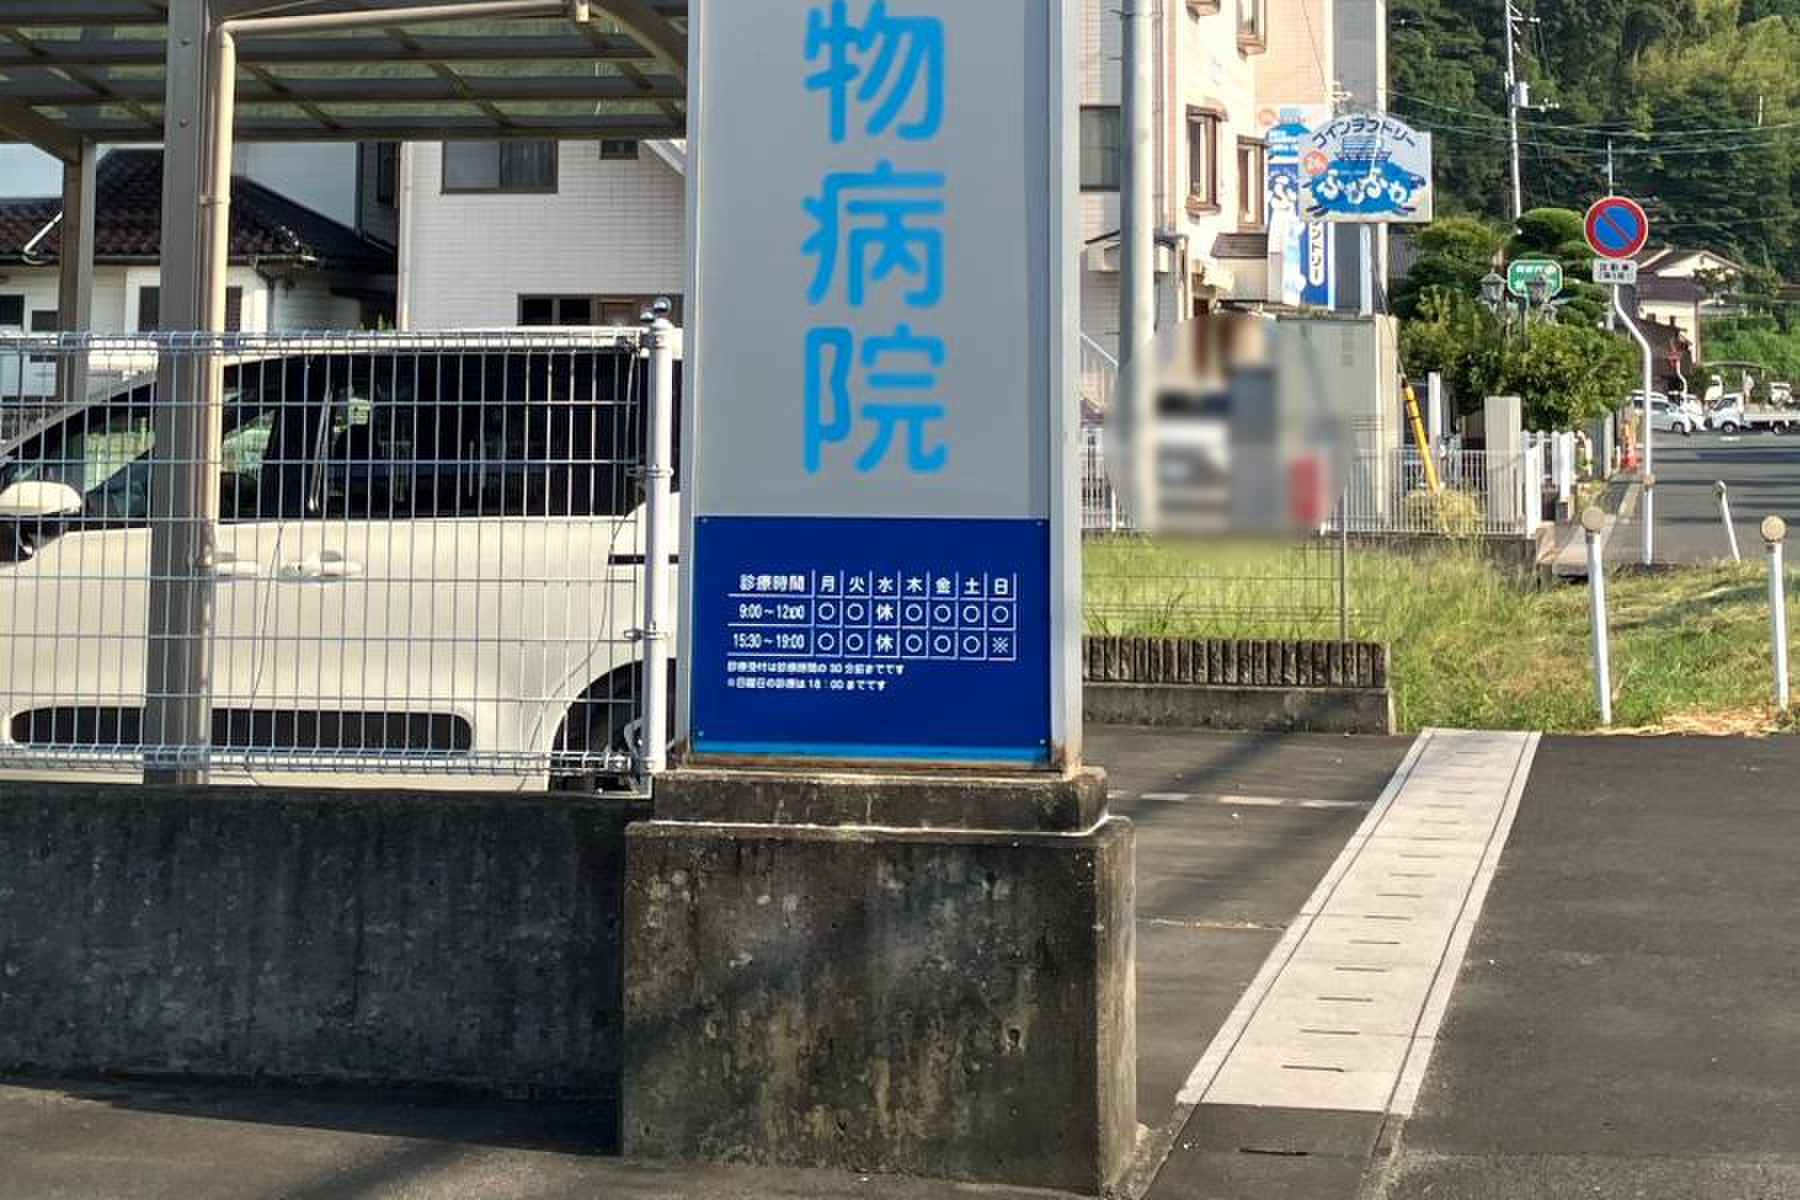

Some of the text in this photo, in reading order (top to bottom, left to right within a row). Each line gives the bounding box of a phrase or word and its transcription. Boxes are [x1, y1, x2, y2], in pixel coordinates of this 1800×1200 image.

[740, 574, 1009, 595] 診療時間 月 火 水 木 金 土 日
[876, 603, 894, 622] 休
[876, 633, 894, 653] 休
